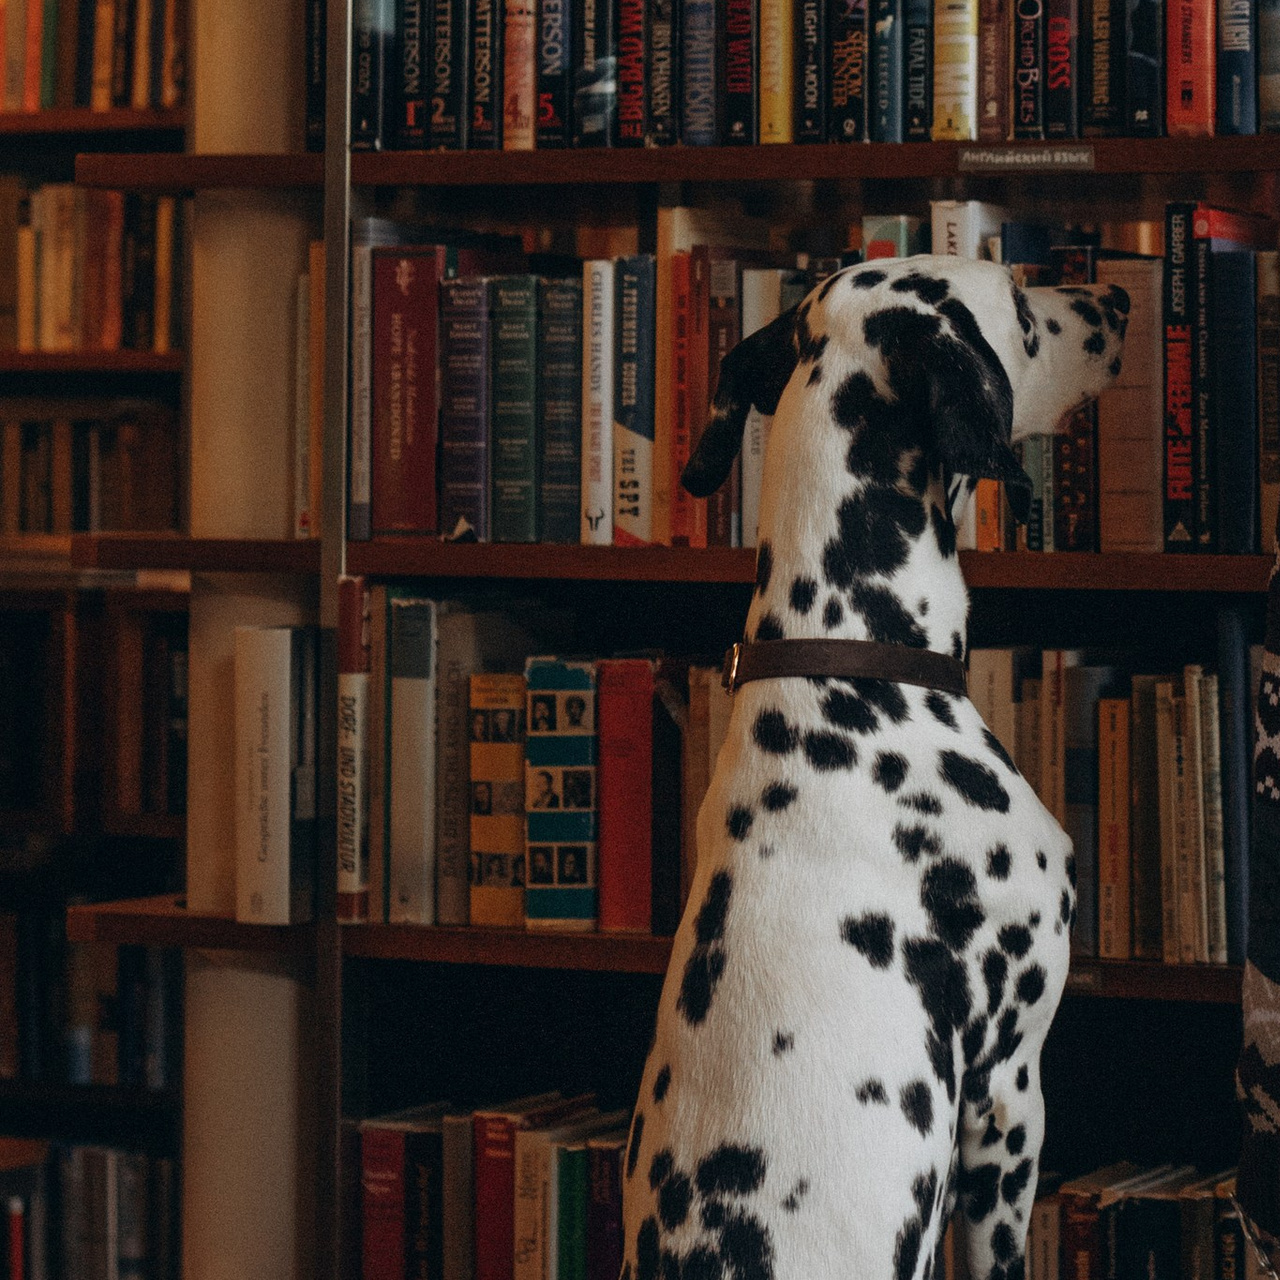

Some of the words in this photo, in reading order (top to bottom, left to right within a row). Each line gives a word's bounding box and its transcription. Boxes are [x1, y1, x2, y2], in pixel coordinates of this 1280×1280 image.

[652, 24, 672, 48] IRIS
[804, 2, 818, 44] LIGHT
[1179, 6, 1192, 65] STRANGERS
[1221, 20, 1250, 53] LIGHT
[618, 36, 643, 80] BAD
[726, 39, 750, 94] WATCH
[847, 29, 863, 99] SHADOW
[909, 28, 925, 72] FATAL
[1048, 17, 1070, 89] CROSS
[357, 52, 372, 95] crazy
[651, 50, 671, 116] JOHANSEN
[684, 29, 713, 133] PATTERSON
[804, 64, 818, 109] MOON
[831, 40, 848, 107] HUNTER
[878, 45, 889, 110] FLEECED
[909, 75, 925, 109] TIDE
[1092, 40, 1109, 105] WARNING
[431, 97, 446, 123] 2
[507, 94, 522, 122] 4
[538, 93, 554, 123] 5
[618, 81, 643, 120] BIG
[1017, 67, 1042, 123] BLUES
[1171, 213, 1186, 265] GARBER
[1197, 242, 1207, 278] RUSSIA
[591, 271, 602, 337] CHARLES
[1171, 267, 1186, 317] JOSEPH
[1198, 282, 1207, 304] AND
[389, 313, 403, 355] HOPE
[1198, 307, 1208, 327] THE
[590, 342, 601, 393] HANDY
[1198, 329, 1210, 379] CLASSICS
[389, 362, 403, 461] ABANDONED
[619, 480, 639, 517] SPY
[340, 696, 357, 740] DORF-
[340, 747, 357, 776] UND
[339, 782, 357, 873] STADTKULTUR
